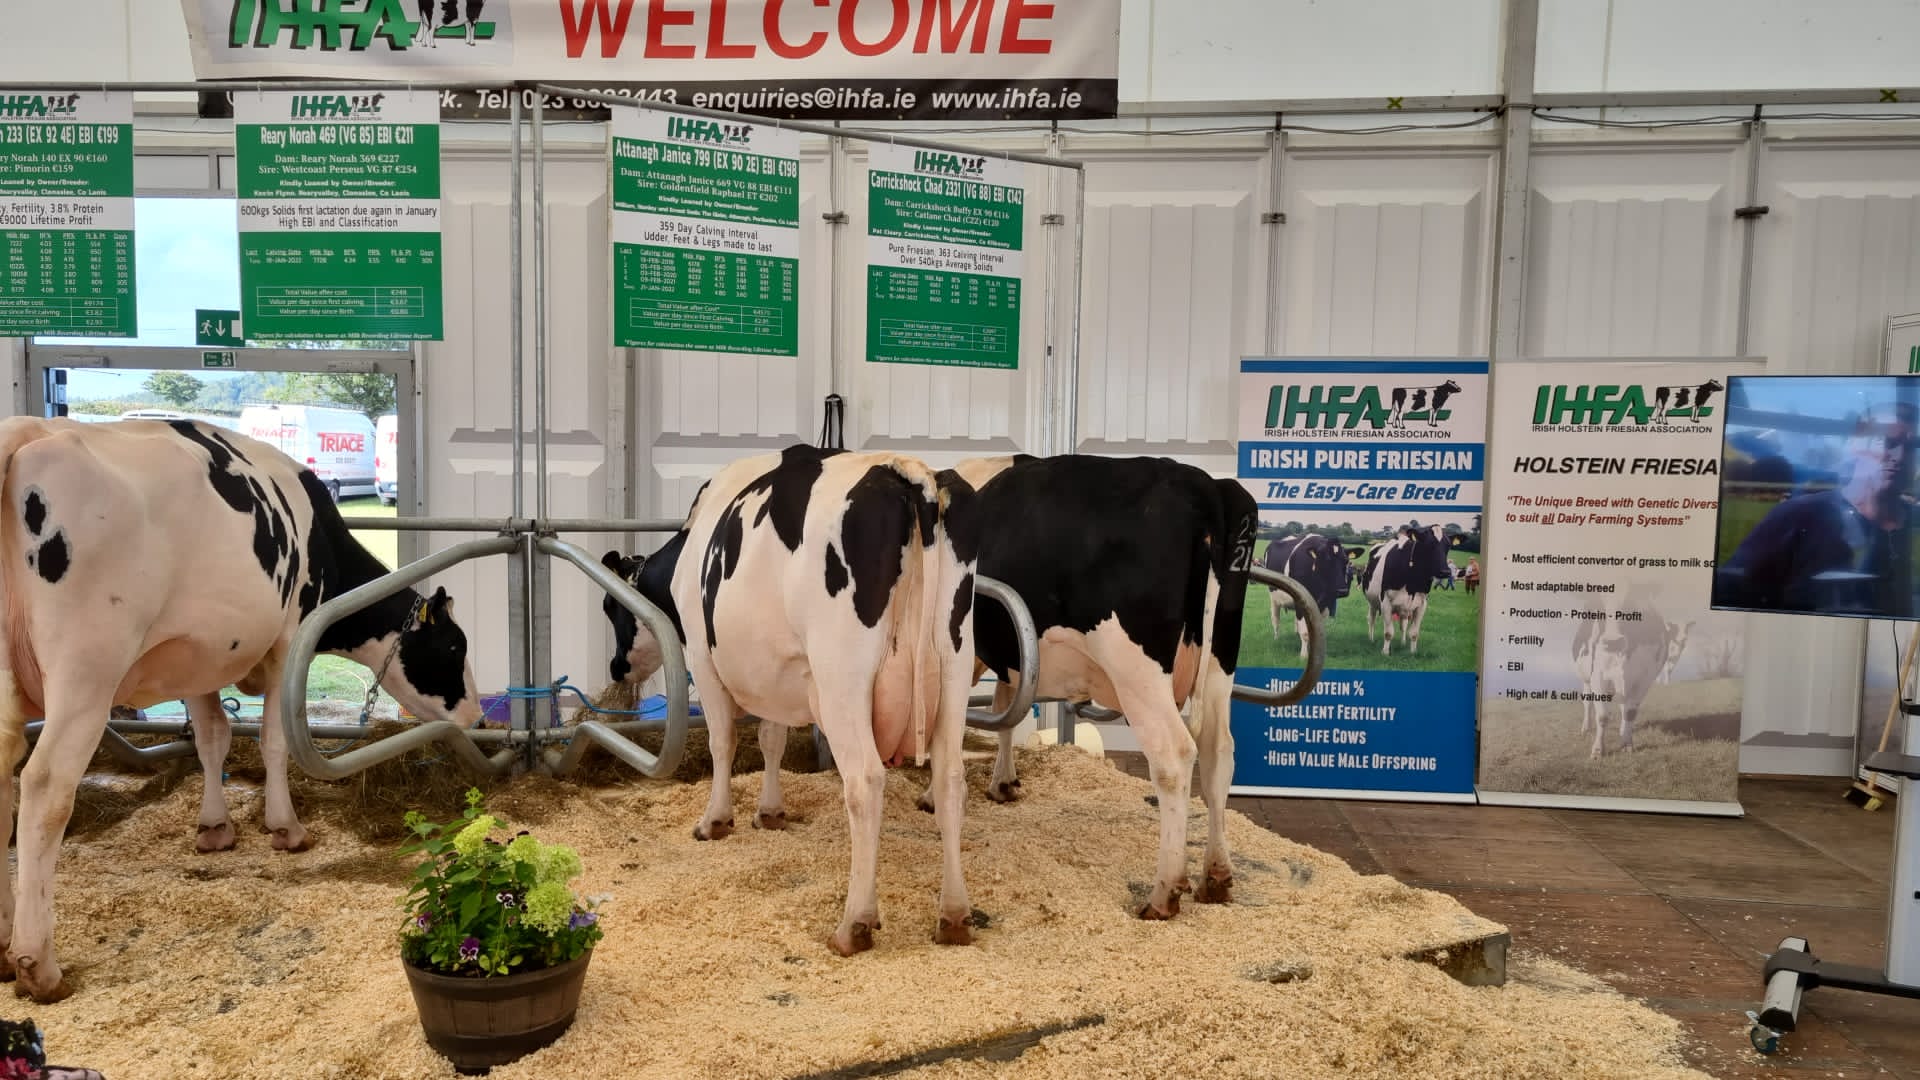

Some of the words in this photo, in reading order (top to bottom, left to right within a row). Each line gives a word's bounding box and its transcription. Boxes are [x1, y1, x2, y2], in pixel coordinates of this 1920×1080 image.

[229, 0, 415, 50] IHFA
[560, 0, 1056, 59] WELCOME
[291, 95, 352, 116] IHFA
[692, 87, 916, 111] enquiries@ihfa.ie
[932, 87, 1082, 109] www.ihfa.ie
[7, 126, 22, 143] 233
[26, 125, 42, 144] (EX
[46, 126, 57, 143] 92
[61, 126, 75, 145] 4E)
[79, 126, 93, 143] EBI
[97, 126, 118, 143] €199
[261, 127, 286, 148] Reary
[289, 127, 316, 144] Norah
[319, 127, 336, 144] 469
[339, 127, 357, 145] (VG
[359, 127, 374, 145] 85)
[377, 127, 392, 144] EBI
[395, 127, 414, 144] €211
[667, 117, 725, 143] IHFA
[275, 155, 298, 163] Dam:
[301, 155, 327, 166] Reary
[329, 155, 357, 163] Norah
[378, 155, 400, 163] €227
[615, 140, 659, 164] Attanagh
[662, 145, 691, 165] Janice
[695, 149, 710, 167] 799
[713, 151, 729, 170] (EX
[732, 154, 743, 171] 90
[762, 158, 775, 175] EBI
[779, 160, 797, 178] €198
[914, 151, 961, 173] IHFA
[259, 166, 279, 174] Sire:
[282, 165, 326, 174] Westcoast
[329, 166, 364, 174] Perseus
[367, 166, 380, 174] VG
[382, 166, 392, 174] 87
[871, 173, 921, 193] Carrickshock
[924, 178, 942, 195] Chad
[964, 183, 976, 199] (VG
[994, 187, 1005, 203] EBI
[1008, 189, 1022, 205] €142
[73, 203, 103, 213] Protein
[240, 206, 270, 216] 600kgs
[272, 205, 296, 215] Solids
[298, 206, 313, 215] first
[316, 206, 349, 215] lactation
[352, 206, 368, 215] due
[370, 207, 392, 217] again
[395, 207, 403, 215] in
[405, 207, 437, 218] January
[30, 215, 65, 225] Lifetime
[69, 215, 92, 225] Profit
[279, 218, 297, 229] High
[302, 218, 315, 226] EBI
[319, 218, 335, 226] and
[338, 218, 398, 227] Classification
[660, 221, 674, 231] 359
[678, 222, 692, 234] Day
[696, 224, 725, 238] Calving
[728, 228, 758, 240] Interval
[674, 234, 690, 245] Feet
[694, 237, 699, 245] &
[702, 237, 721, 248] Legs
[724, 240, 746, 249] made
[748, 241, 755, 250] to
[758, 242, 772, 252] last
[889, 243, 904, 253] Pure
[939, 248, 950, 257] 363
[953, 250, 977, 262] Calving
[980, 251, 1003, 263] Interval
[900, 255, 916, 264] Over
[919, 257, 943, 268] 540kgs
[946, 260, 971, 271] Average
[974, 262, 993, 272] Solids
[1265, 385, 1390, 429] IHFA
[1533, 385, 1653, 425] IHFA
[1264, 429, 1289, 437] IRISH
[1292, 429, 1339, 438] HOLSTEIN
[1341, 430, 1385, 438] FRIESIAN
[1387, 431, 1451, 439] ASSOCIATION
[1605, 425, 1648, 433] FRIESIAN
[1650, 425, 1712, 433] ASSOCIATION
[317, 432, 364, 452] TRIACE
[1250, 450, 1308, 469] IRISH
[1315, 450, 1370, 470] PURE
[1376, 451, 1472, 470] FRIESIAN
[1513, 457, 1625, 474] HOLSTEIN
[1267, 482, 1301, 498] The
[1304, 483, 1397, 502] Easy-Care
[1401, 484, 1460, 501] Breed
[1507, 496, 1532, 506] "The
[1535, 496, 1573, 508] Unique
[1576, 497, 1608, 508] Breed
[1612, 498, 1634, 508] with
[1637, 498, 1680, 509] Genetic
[1506, 513, 1516, 522] to
[1519, 513, 1539, 523] suit
[1542, 514, 1554, 525] all
[1557, 514, 1585, 526] Dairy
[1589, 514, 1633, 527] Farming
[1637, 515, 1690, 526] Systems"
[1229, 545, 1252, 573] 21
[1512, 554, 1534, 563] Most
[1537, 555, 1575, 564] efficient
[1578, 556, 1624, 565] convertor
[1627, 556, 1636, 566] of
[1639, 558, 1666, 568] grass
[1668, 558, 1678, 567] to
[1681, 557, 1701, 567] milk
[1511, 581, 1534, 591] Most
[1536, 582, 1584, 593] adaptable
[1587, 583, 1615, 593] breed
[1509, 609, 1562, 618] Production
[1571, 610, 1606, 620] Protein
[1615, 611, 1642, 621] Profit
[1509, 635, 1544, 647] Fertility
[1507, 662, 1524, 671] EBI
[1353, 681, 1364, 696] %
[1506, 689, 1528, 700] High
[1531, 690, 1548, 699] calf
[1551, 691, 1557, 700] &
[1560, 691, 1578, 701] cull
[1580, 693, 1612, 702] values
[1269, 705, 1333, 719] EXCELLENT
[1337, 705, 1396, 721] FERTILITY
[1269, 727, 1329, 743] LONG-LIFE
[1332, 728, 1366, 744] COWS
[1268, 752, 1296, 766] HIGH
[1299, 752, 1335, 768] VALUE
[1338, 754, 1369, 769] MALE
[1372, 754, 1436, 771] OFFSPRING
